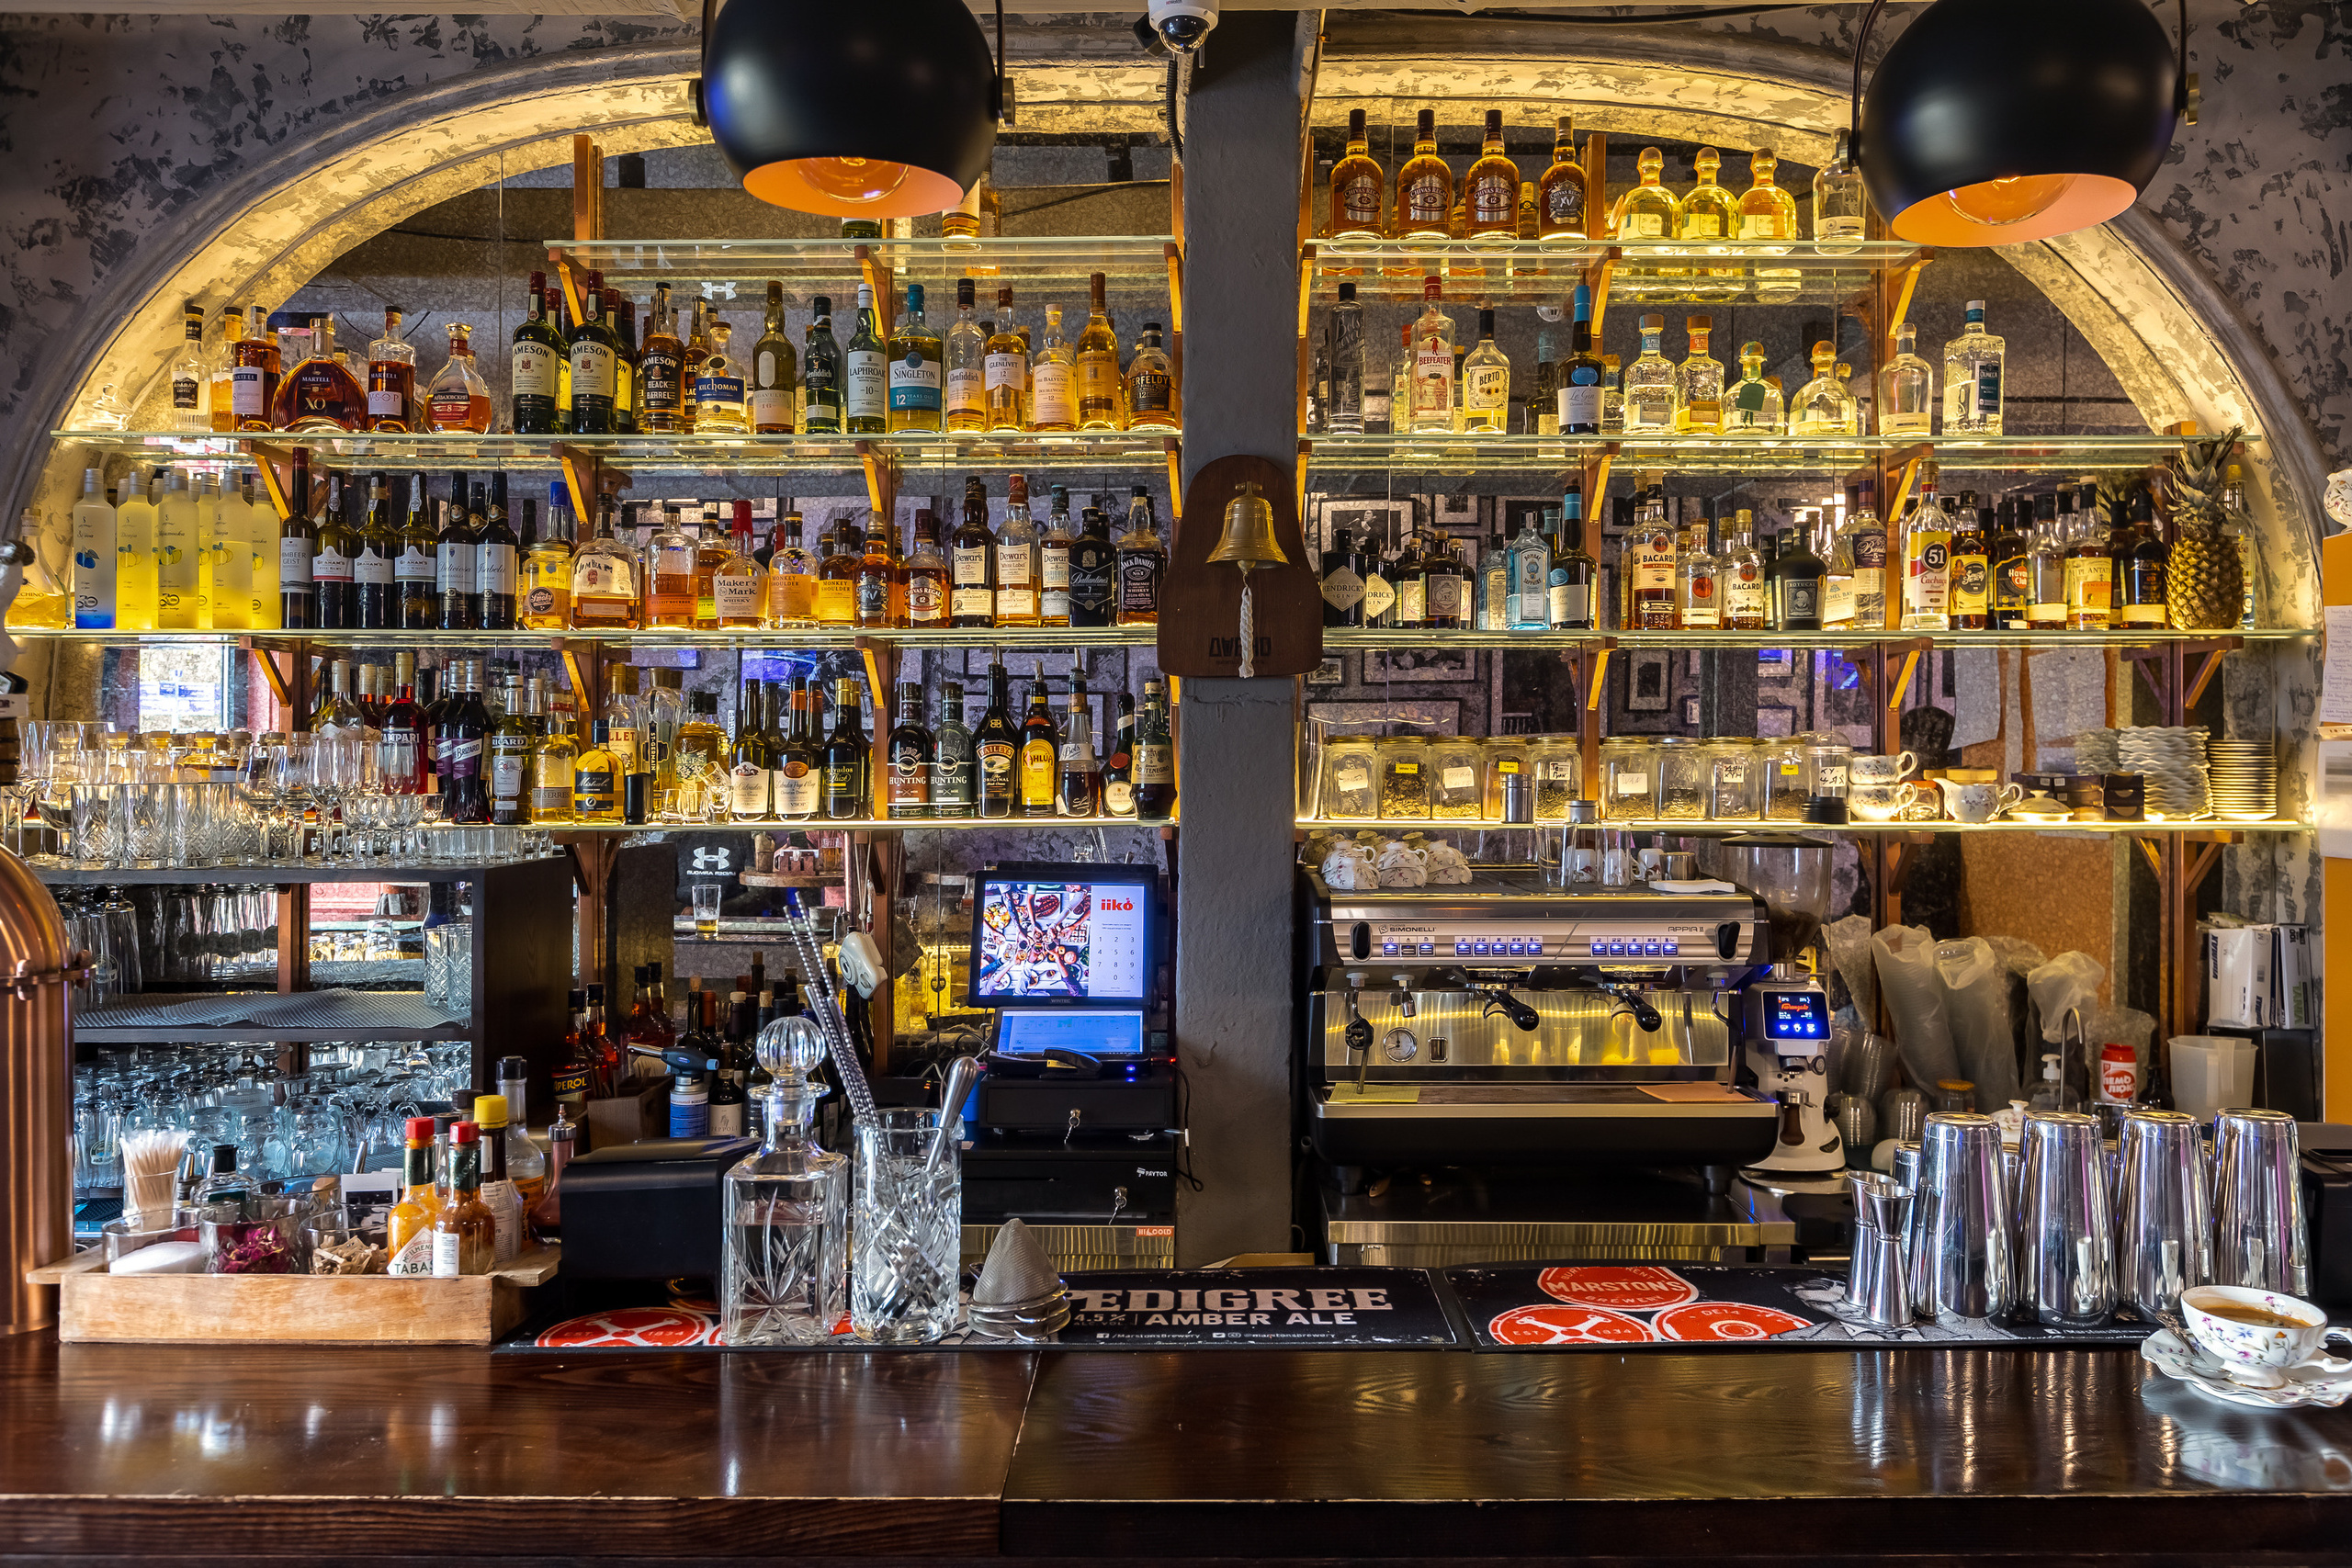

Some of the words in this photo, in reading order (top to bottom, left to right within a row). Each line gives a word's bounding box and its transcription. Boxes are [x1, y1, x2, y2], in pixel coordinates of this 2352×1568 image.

[1344, 187, 1365, 197] CHIVAS
[1410, 187, 1431, 198] CHIVAS
[1474, 187, 1494, 198] CHIVAS
[1495, 187, 1513, 197] REGAL
[1559, 196, 1575, 208] XV
[1419, 356, 1452, 367] BEEFEATER
[950, 372, 979, 383] Glenfiddich
[648, 380, 669, 389] BLACK
[865, 386, 874, 394] 10
[647, 390, 671, 400] BARREL
[896, 394, 906, 405] 12
[1580, 389, 1595, 400] Gin
[304, 397, 326, 411] XO
[955, 553, 983, 562] Dewar's
[1000, 551, 1028, 561] Dewar's
[1928, 548, 1944, 564] 51
[1121, 558, 1135, 570] JACK
[1135, 556, 1156, 570] DANIEL'S
[1070, 571, 1109, 584] Ballantine's
[728, 587, 757, 595] Mark
[861, 590, 877, 600] XV
[924, 588, 943, 597] REGAL
[1713, 610, 1719, 618] 8
[608, 730, 636, 741] LLET
[492, 738, 524, 746] RICARD
[457, 742, 481, 760] BRIZARD
[979, 746, 1012, 756] BAILEYS
[1022, 750, 1054, 767] KAHLÚA
[823, 765, 854, 773] Calvados
[577, 776, 610, 787] Mistral
[888, 776, 927, 785] HUNTING
[930, 776, 967, 785] HUNTING
[548, 791, 571, 799] ERRES
[1101, 897, 1135, 911] iiko
[553, 1077, 587, 1092] APEROL
[1545, 1280, 1688, 1293] MARSTON'S
[1585, 1294, 1665, 1305] BREWERY
[1700, 1309, 1741, 1317] DE14
[1145, 1313, 1272, 1325] AMBER
[1285, 1313, 1358, 1325] ALE
